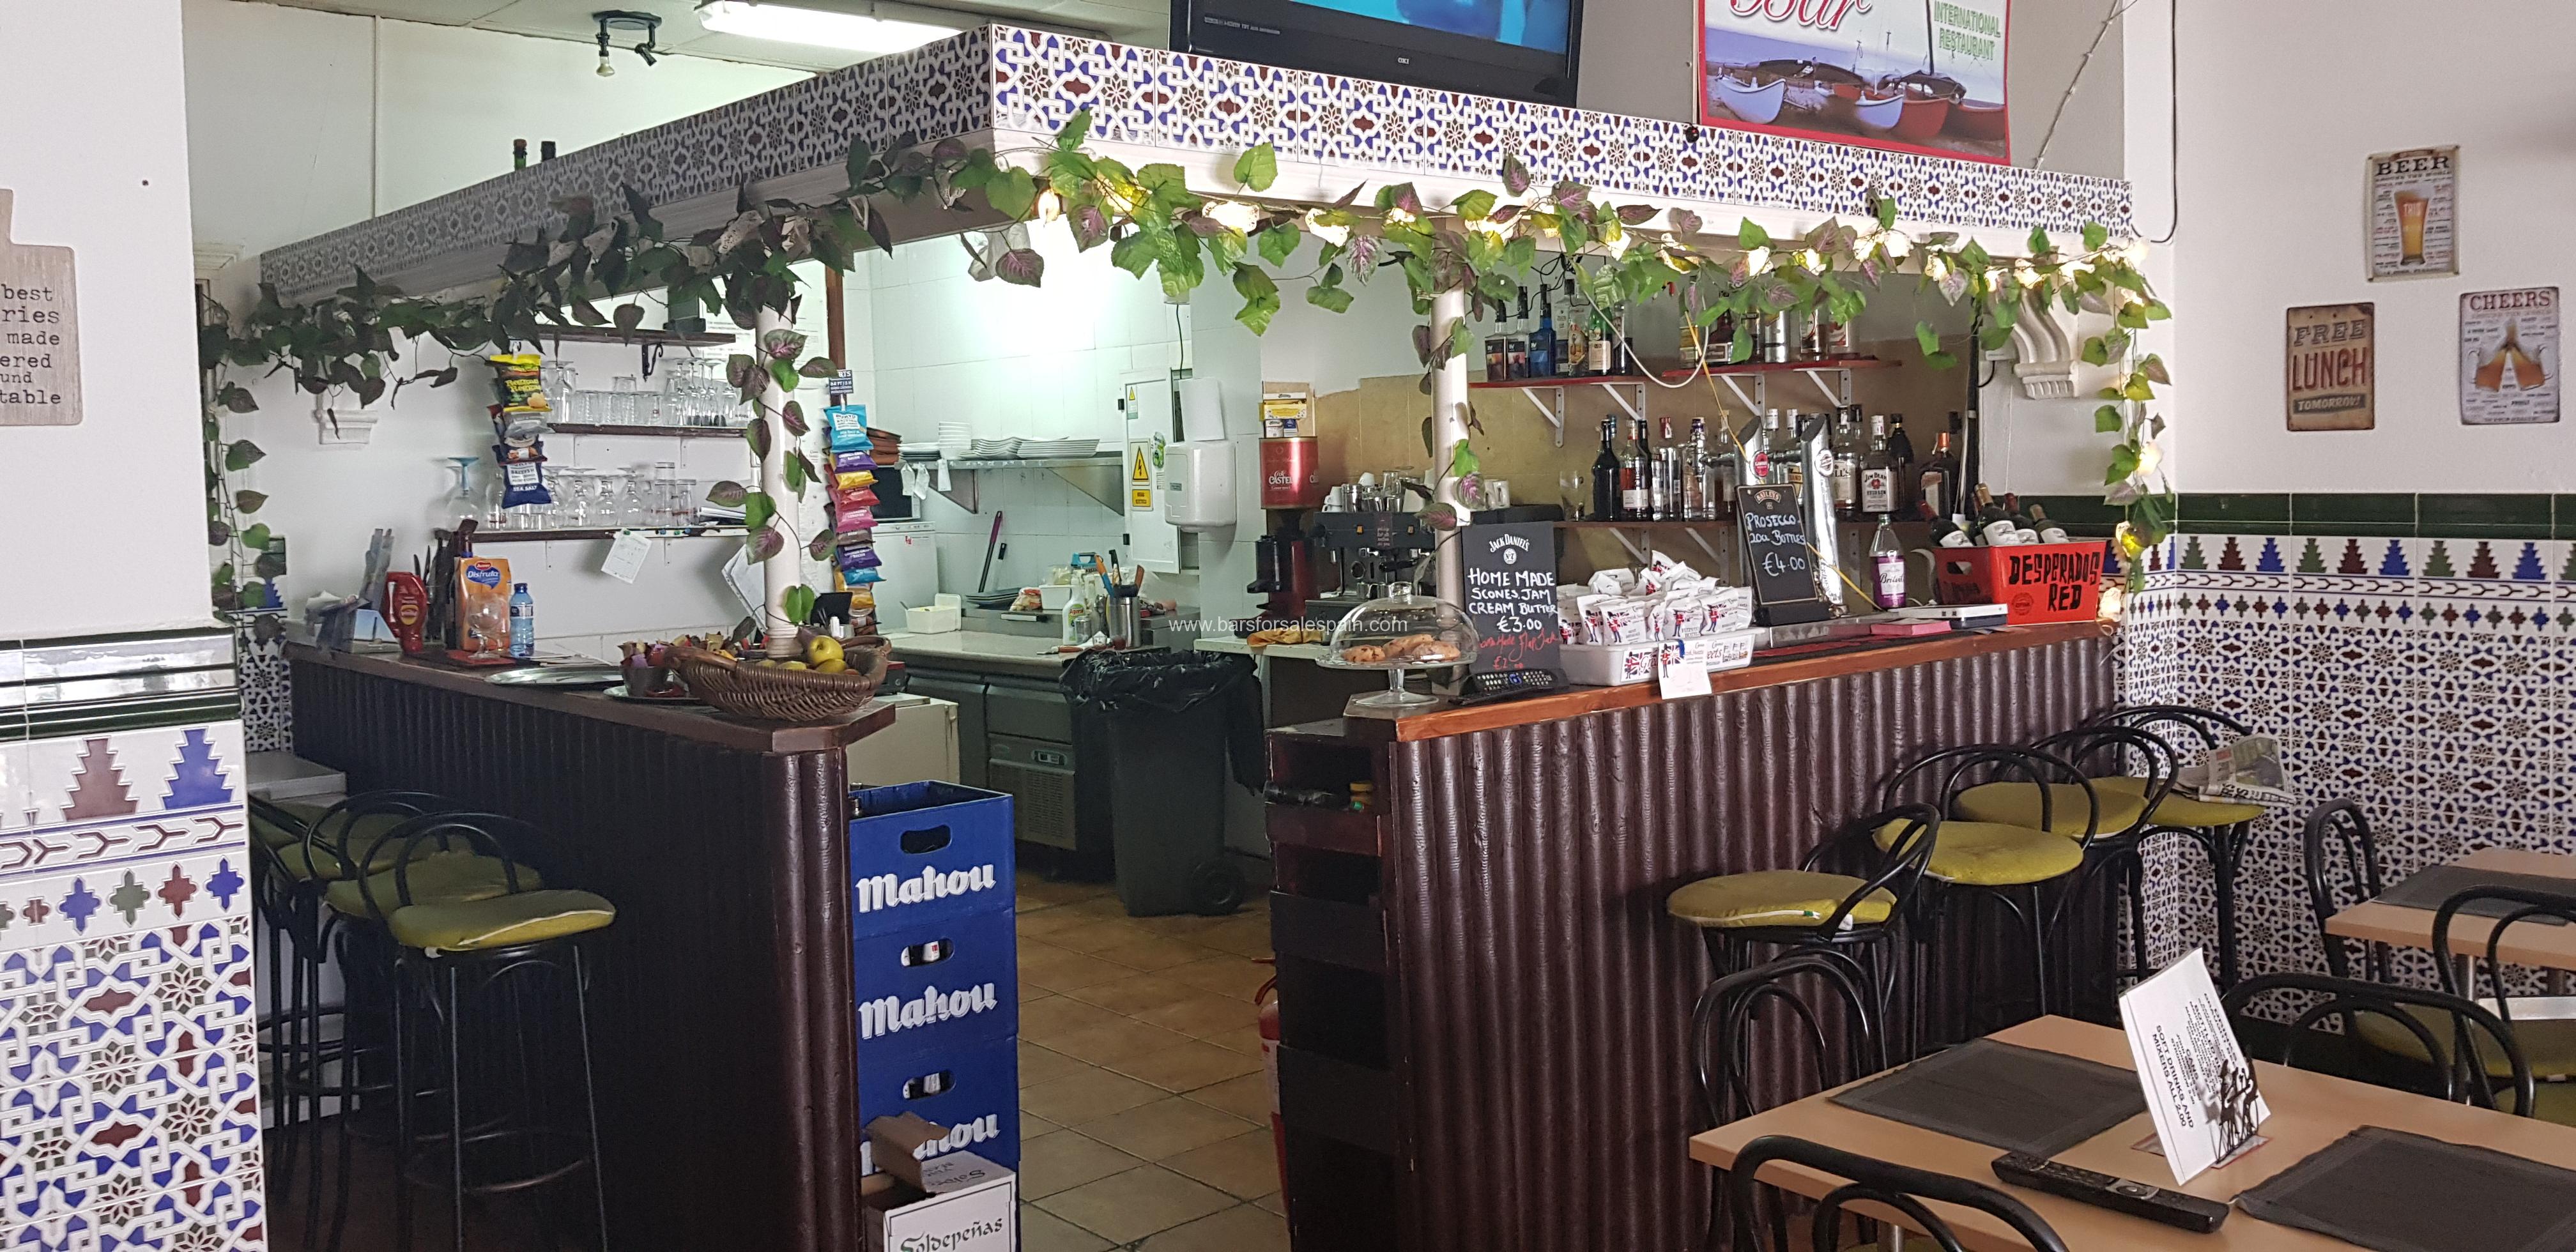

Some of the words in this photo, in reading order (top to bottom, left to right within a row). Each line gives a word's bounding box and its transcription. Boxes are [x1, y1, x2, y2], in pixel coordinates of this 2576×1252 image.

[1934, 0, 2000, 38] INTERNATIONAL
[1939, 27, 1995, 61] RESTAURANT
[2376, 156, 2450, 176] BEER
[1, 284, 52, 301] best
[2470, 290, 2550, 310] CHEERS
[2, 306, 59, 323] ries
[6, 331, 59, 345] made
[2294, 319, 2367, 347] FREE
[0, 353, 52, 368] ered
[2292, 347, 2367, 392] LUNCH
[0, 390, 61, 404] table
[1756, 491, 1781, 501] BAILEYS
[1489, 537, 1505, 553] JACK
[1468, 567, 1510, 586] HOME
[1515, 570, 1555, 586] MADE
[2009, 552, 2101, 585] DESPERADOS
[1521, 588, 1551, 605] JAM
[2047, 583, 2082, 612] RED
[1469, 602, 1514, 616] CREAM
[1518, 602, 1558, 615] BUTTER
[1496, 615, 1542, 632] €3.00
[855, 864, 996, 913] Mahou
[859, 982, 998, 1040] Mahou
[2193, 1004, 2215, 1055] BOTTLED
[2185, 1048, 2200, 1080] CANS
[2152, 1032, 2170, 1078] MIXERS
[2166, 1077, 2179, 1103] ALL
[2175, 1102, 2187, 1128] 2.00
[2156, 1023, 2170, 1055] SOFT
[2166, 1056, 2185, 1102] DRINKS
[2182, 1102, 2195, 1129] AND
